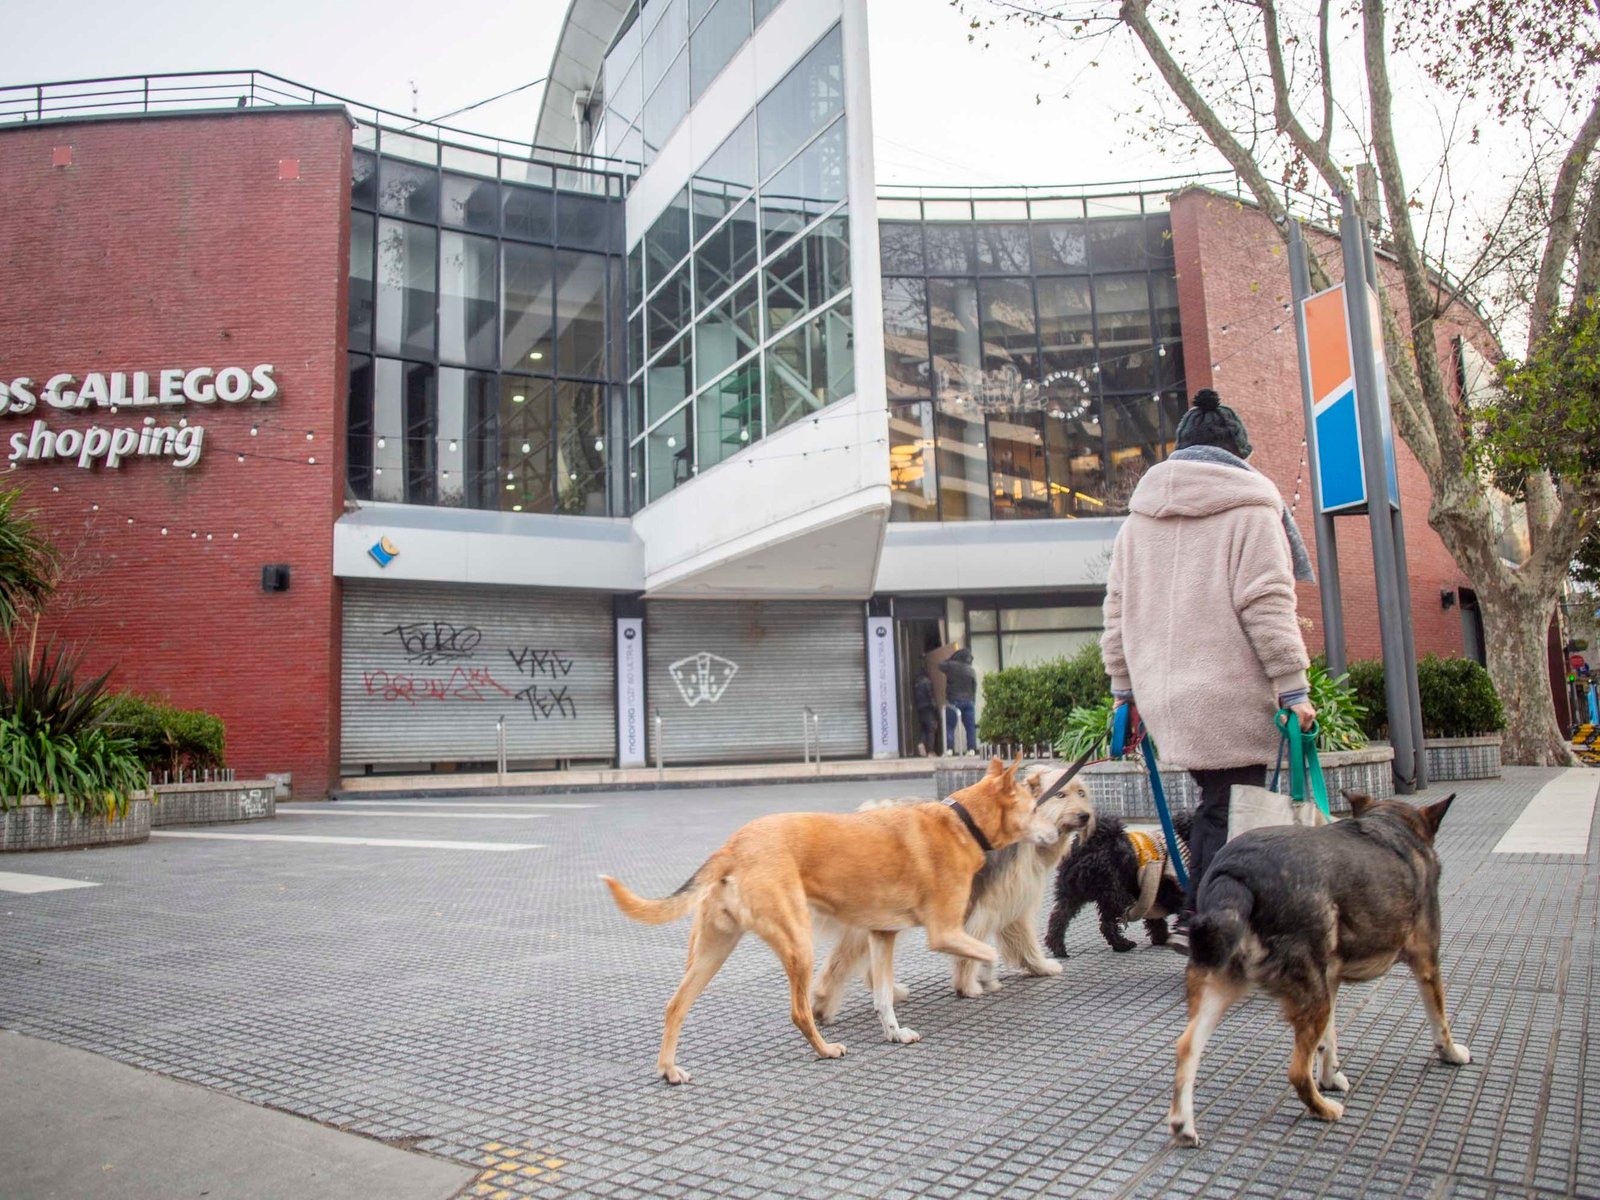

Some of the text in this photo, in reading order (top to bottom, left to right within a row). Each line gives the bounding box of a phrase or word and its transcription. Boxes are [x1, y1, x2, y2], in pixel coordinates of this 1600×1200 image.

[44, 364, 279, 409] GALLEGOS
[8, 416, 206, 469] shopping
[628, 707, 636, 755] motorola
[881, 702, 889, 747] motorola
